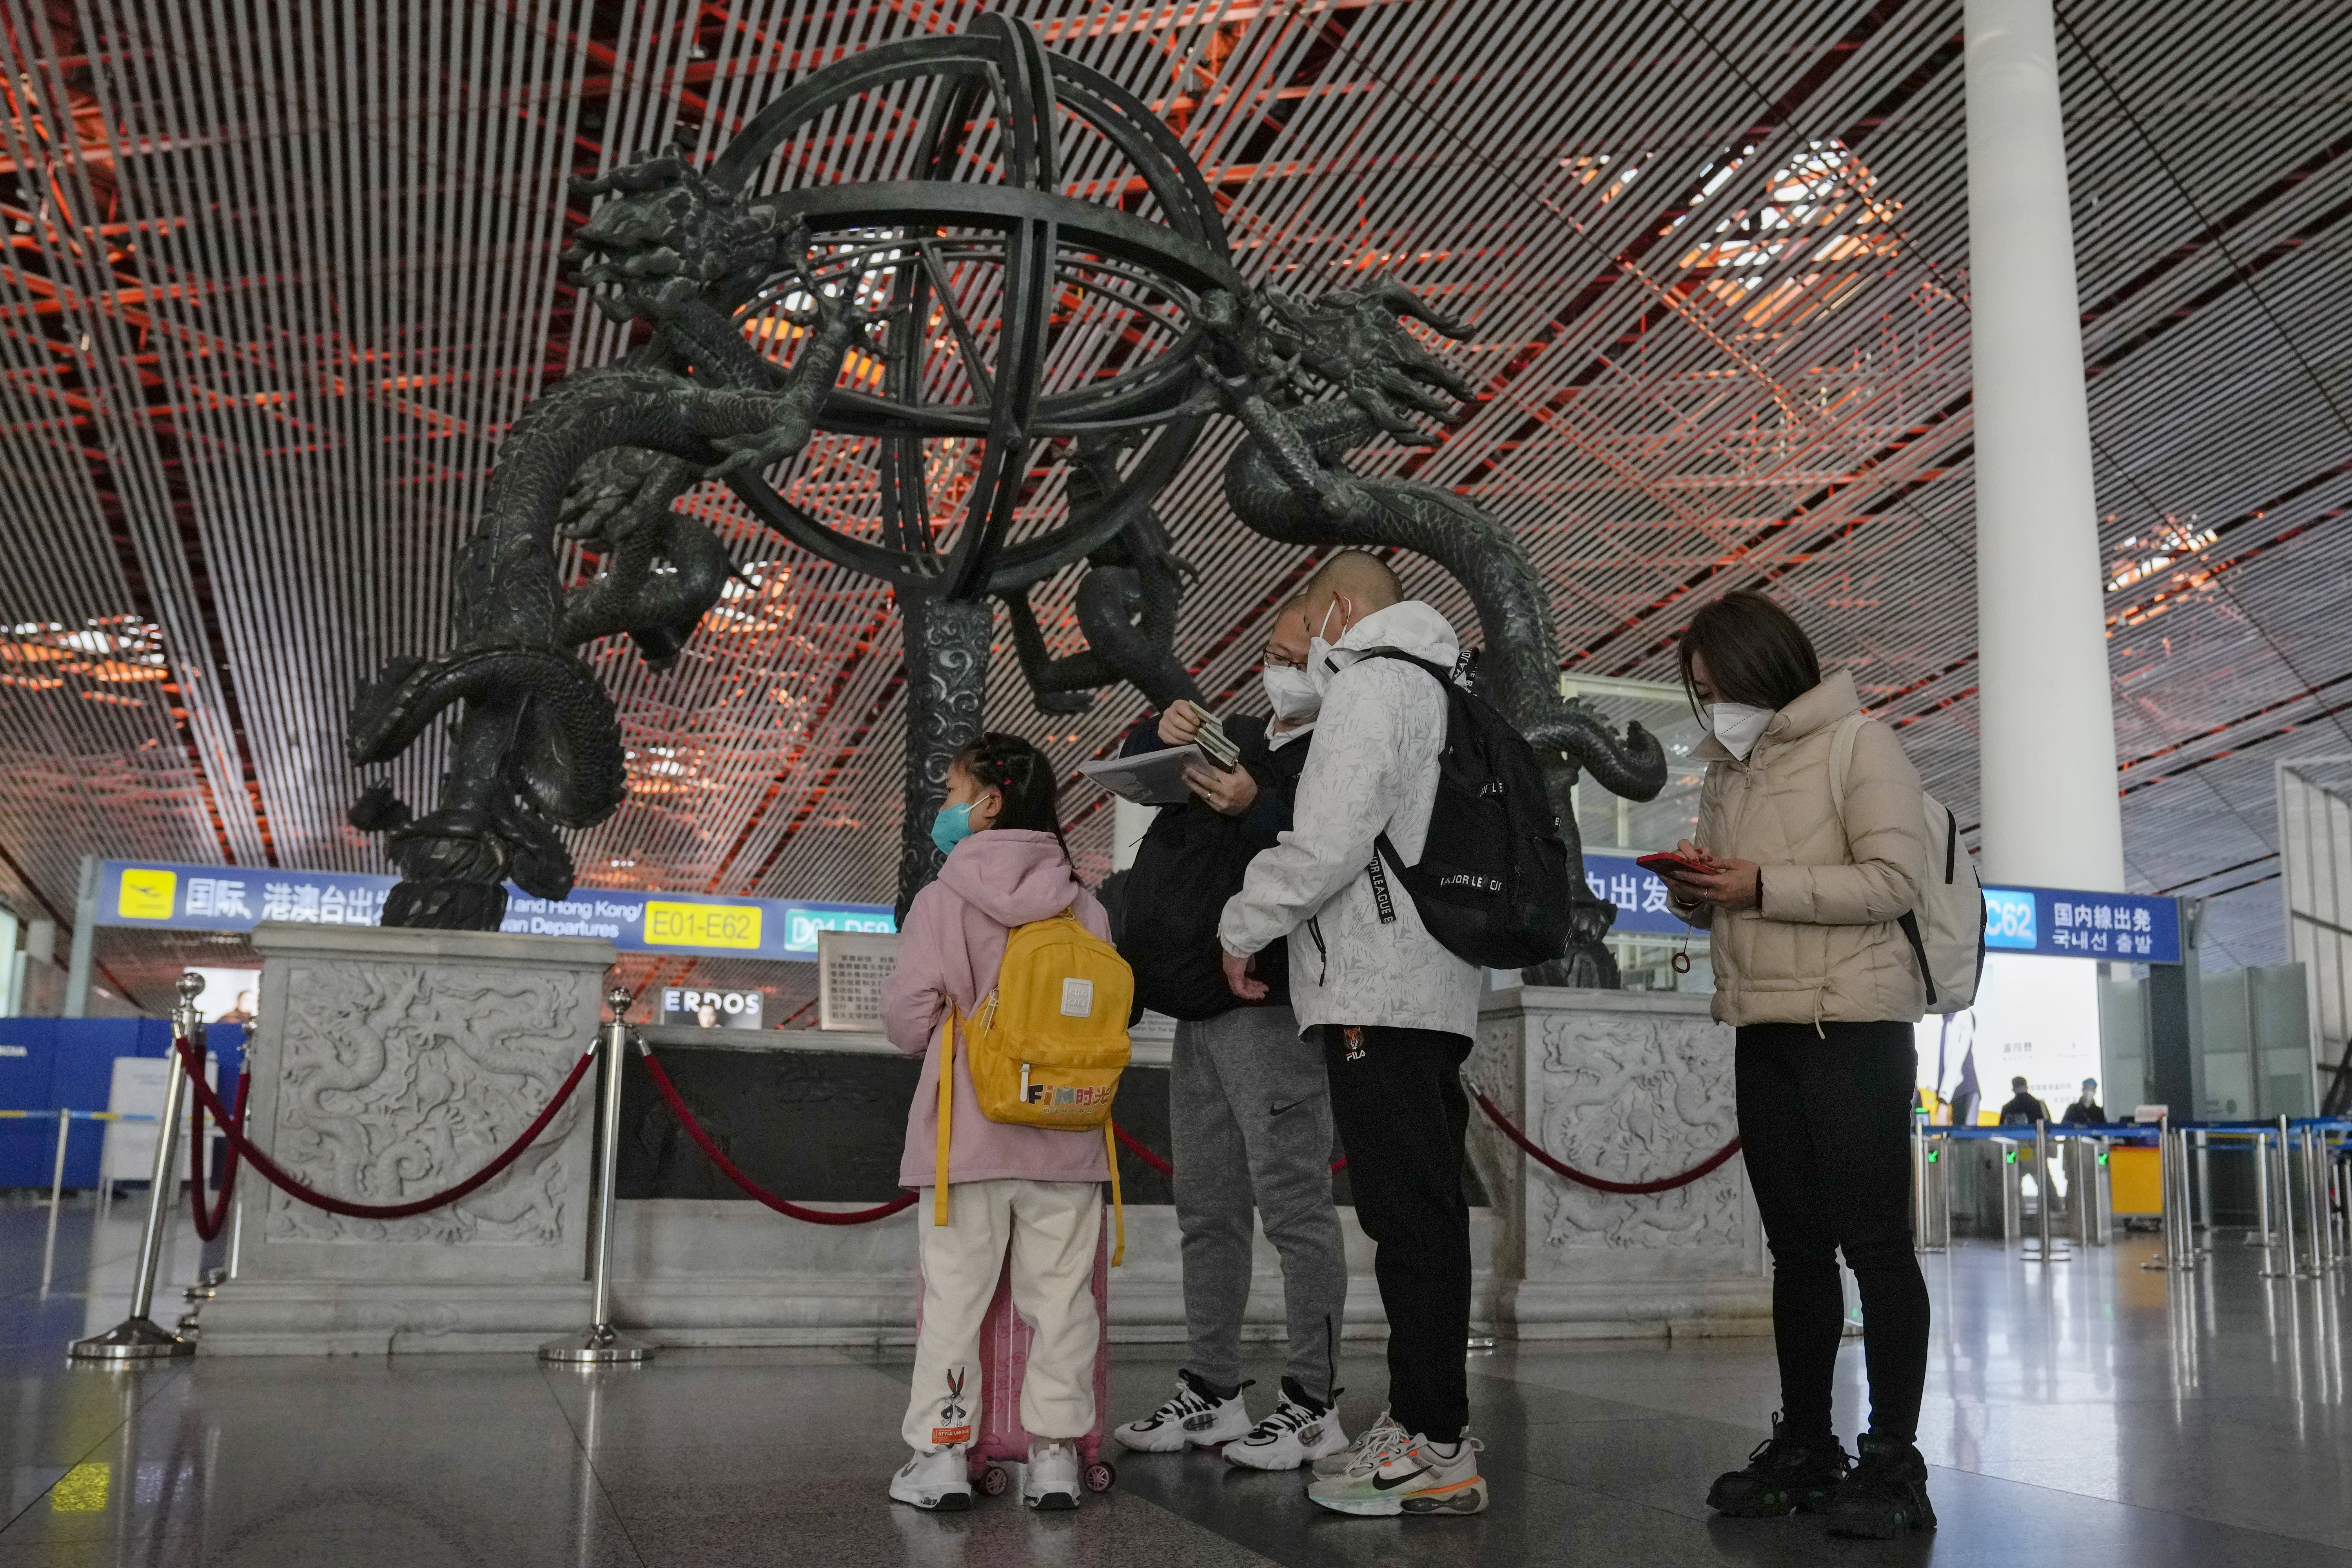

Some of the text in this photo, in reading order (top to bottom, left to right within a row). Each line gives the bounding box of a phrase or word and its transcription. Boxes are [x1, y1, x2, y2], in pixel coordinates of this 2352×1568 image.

[1372, 875, 1392, 915] LEAGUE
[514, 898, 546, 914] and
[548, 900, 593, 920] Hong
[1985, 899, 2033, 937] C62
[530, 916, 619, 938] Departures
[654, 911, 750, 939] E01-E62
[2052, 929, 2153, 955] 국내선 출발
[1346, 1049, 1366, 1062] FILA
